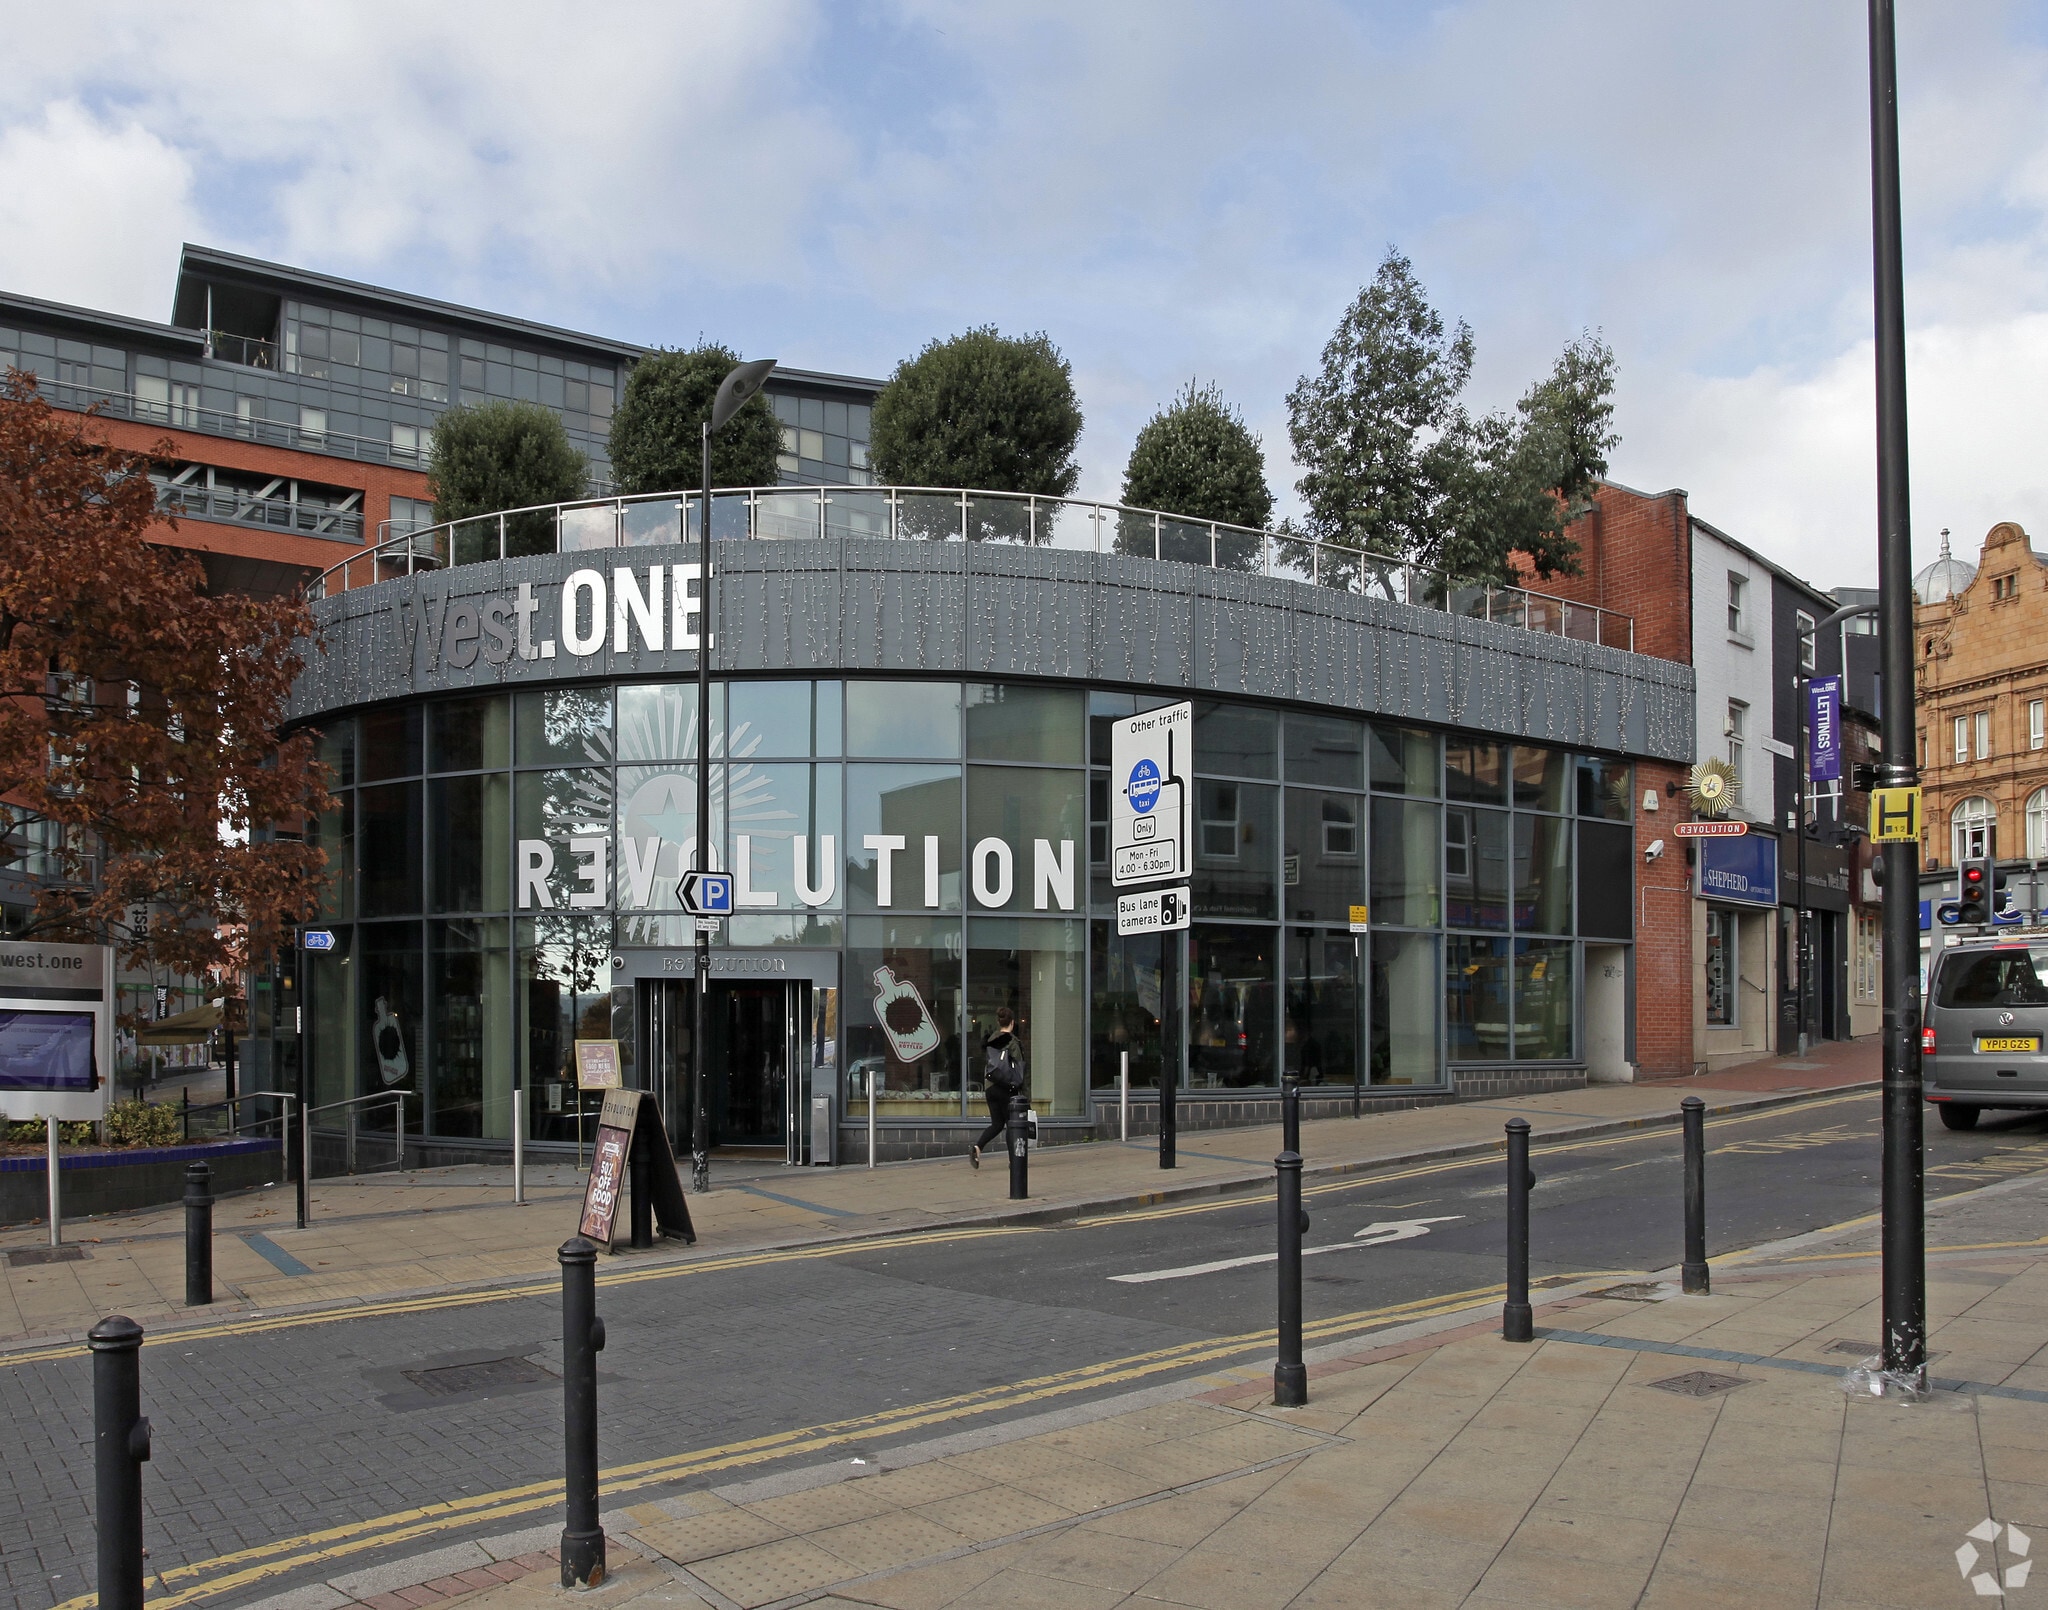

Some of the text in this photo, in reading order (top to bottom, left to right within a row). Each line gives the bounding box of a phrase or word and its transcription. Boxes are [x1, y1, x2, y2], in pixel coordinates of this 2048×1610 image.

[390, 562, 715, 678] West.ONE
[1130, 708, 1189, 734] Other traffic
[1817, 695, 1831, 749] LETTINGS
[1138, 798, 1150, 808] taxi
[1879, 793, 1914, 836] H
[1136, 823, 1153, 834] Only
[1680, 824, 1741, 835] REVOLUTION
[1129, 851, 1144, 861] Mon
[1149, 848, 1159, 858] Fri
[1119, 863, 1136, 875] 4.00
[1143, 860, 1171, 871] 6.30pm
[1707, 869, 1748, 892] SHEPHERD
[706, 880, 725, 907] P
[1120, 899, 1159, 913] Bus lane
[1121, 914, 1158, 928] cameras
[662, 956, 787, 973] REVLUTION
[1985, 1039, 2031, 1049] YP13 GZS
[600, 1160, 614, 1177] 50%
[598, 1176, 612, 1190] OFF
[592, 1189, 612, 1204] FOOD
